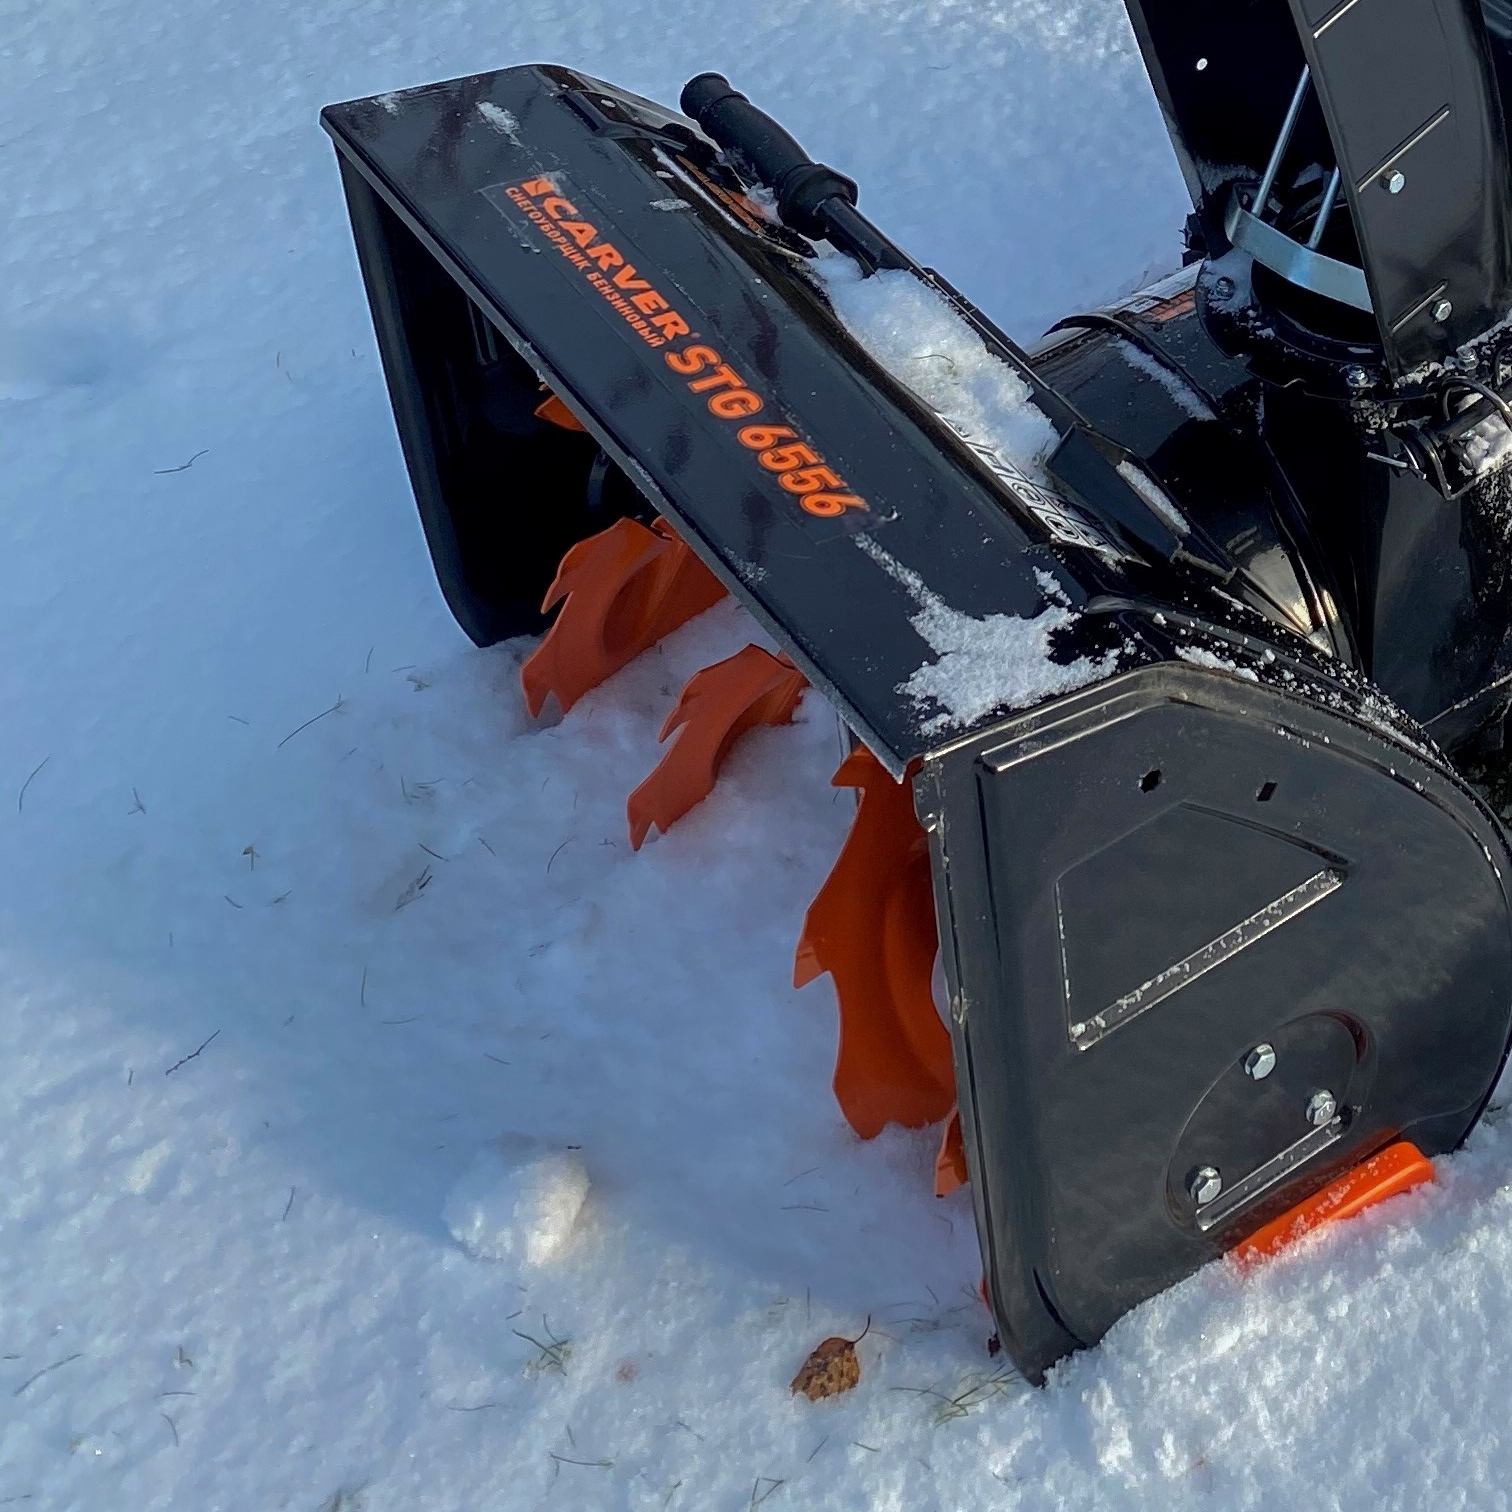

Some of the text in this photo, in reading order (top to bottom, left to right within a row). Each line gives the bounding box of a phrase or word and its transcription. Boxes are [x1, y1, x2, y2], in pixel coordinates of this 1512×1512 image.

[504, 186, 667, 349] СНЕГОУБОРЩИК БЕНЗИНОВЫЙ
[542, 195, 871, 518] CARVER STG 6556
